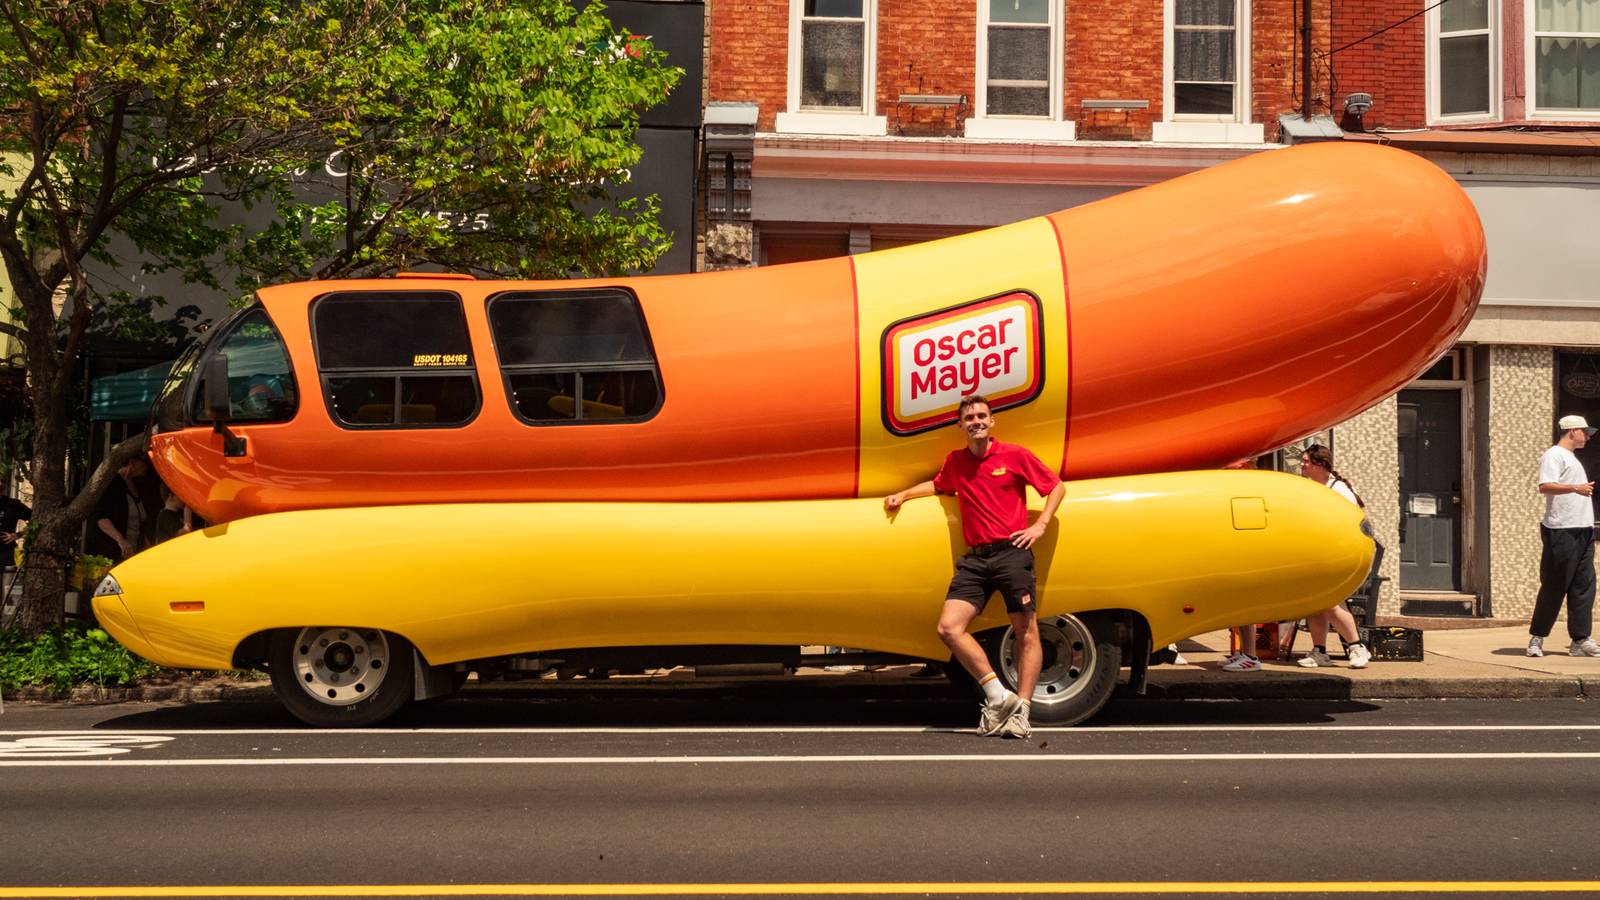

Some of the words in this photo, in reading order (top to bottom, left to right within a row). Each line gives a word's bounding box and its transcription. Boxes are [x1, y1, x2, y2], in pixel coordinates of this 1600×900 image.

[414, 354, 442, 363] USDOT
[913, 318, 1013, 367] Oscar
[911, 346, 1019, 400] Mayer
